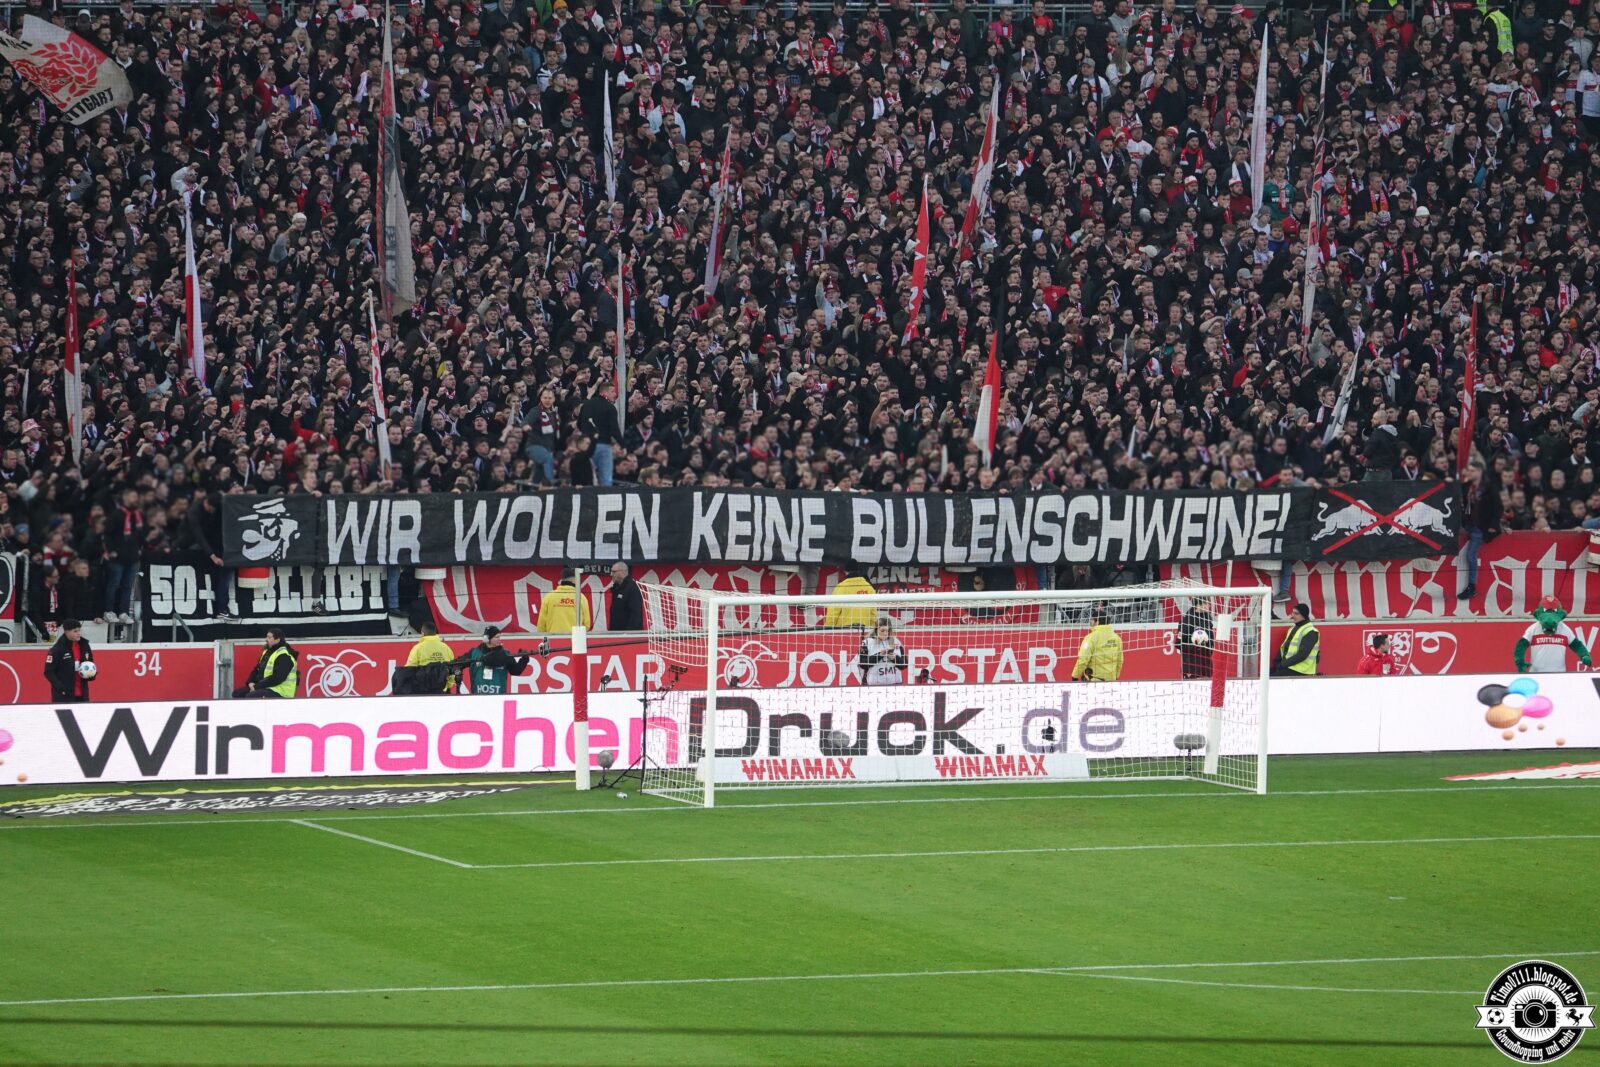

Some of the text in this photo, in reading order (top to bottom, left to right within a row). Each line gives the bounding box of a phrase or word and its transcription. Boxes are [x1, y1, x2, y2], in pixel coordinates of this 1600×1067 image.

[327, 491, 1291, 565] WIR WOLLEN KEINE BULLENSCHWEINE!
[1162, 631, 1182, 655] 3
[134, 651, 162, 677] 34
[776, 647, 1058, 689] JOKRSTAR
[477, 684, 501, 693] HOST
[55, 690, 1126, 778] WirmachenDruck.de
[742, 758, 857, 781] WINAMAX
[935, 754, 1049, 778] WINAMAX
